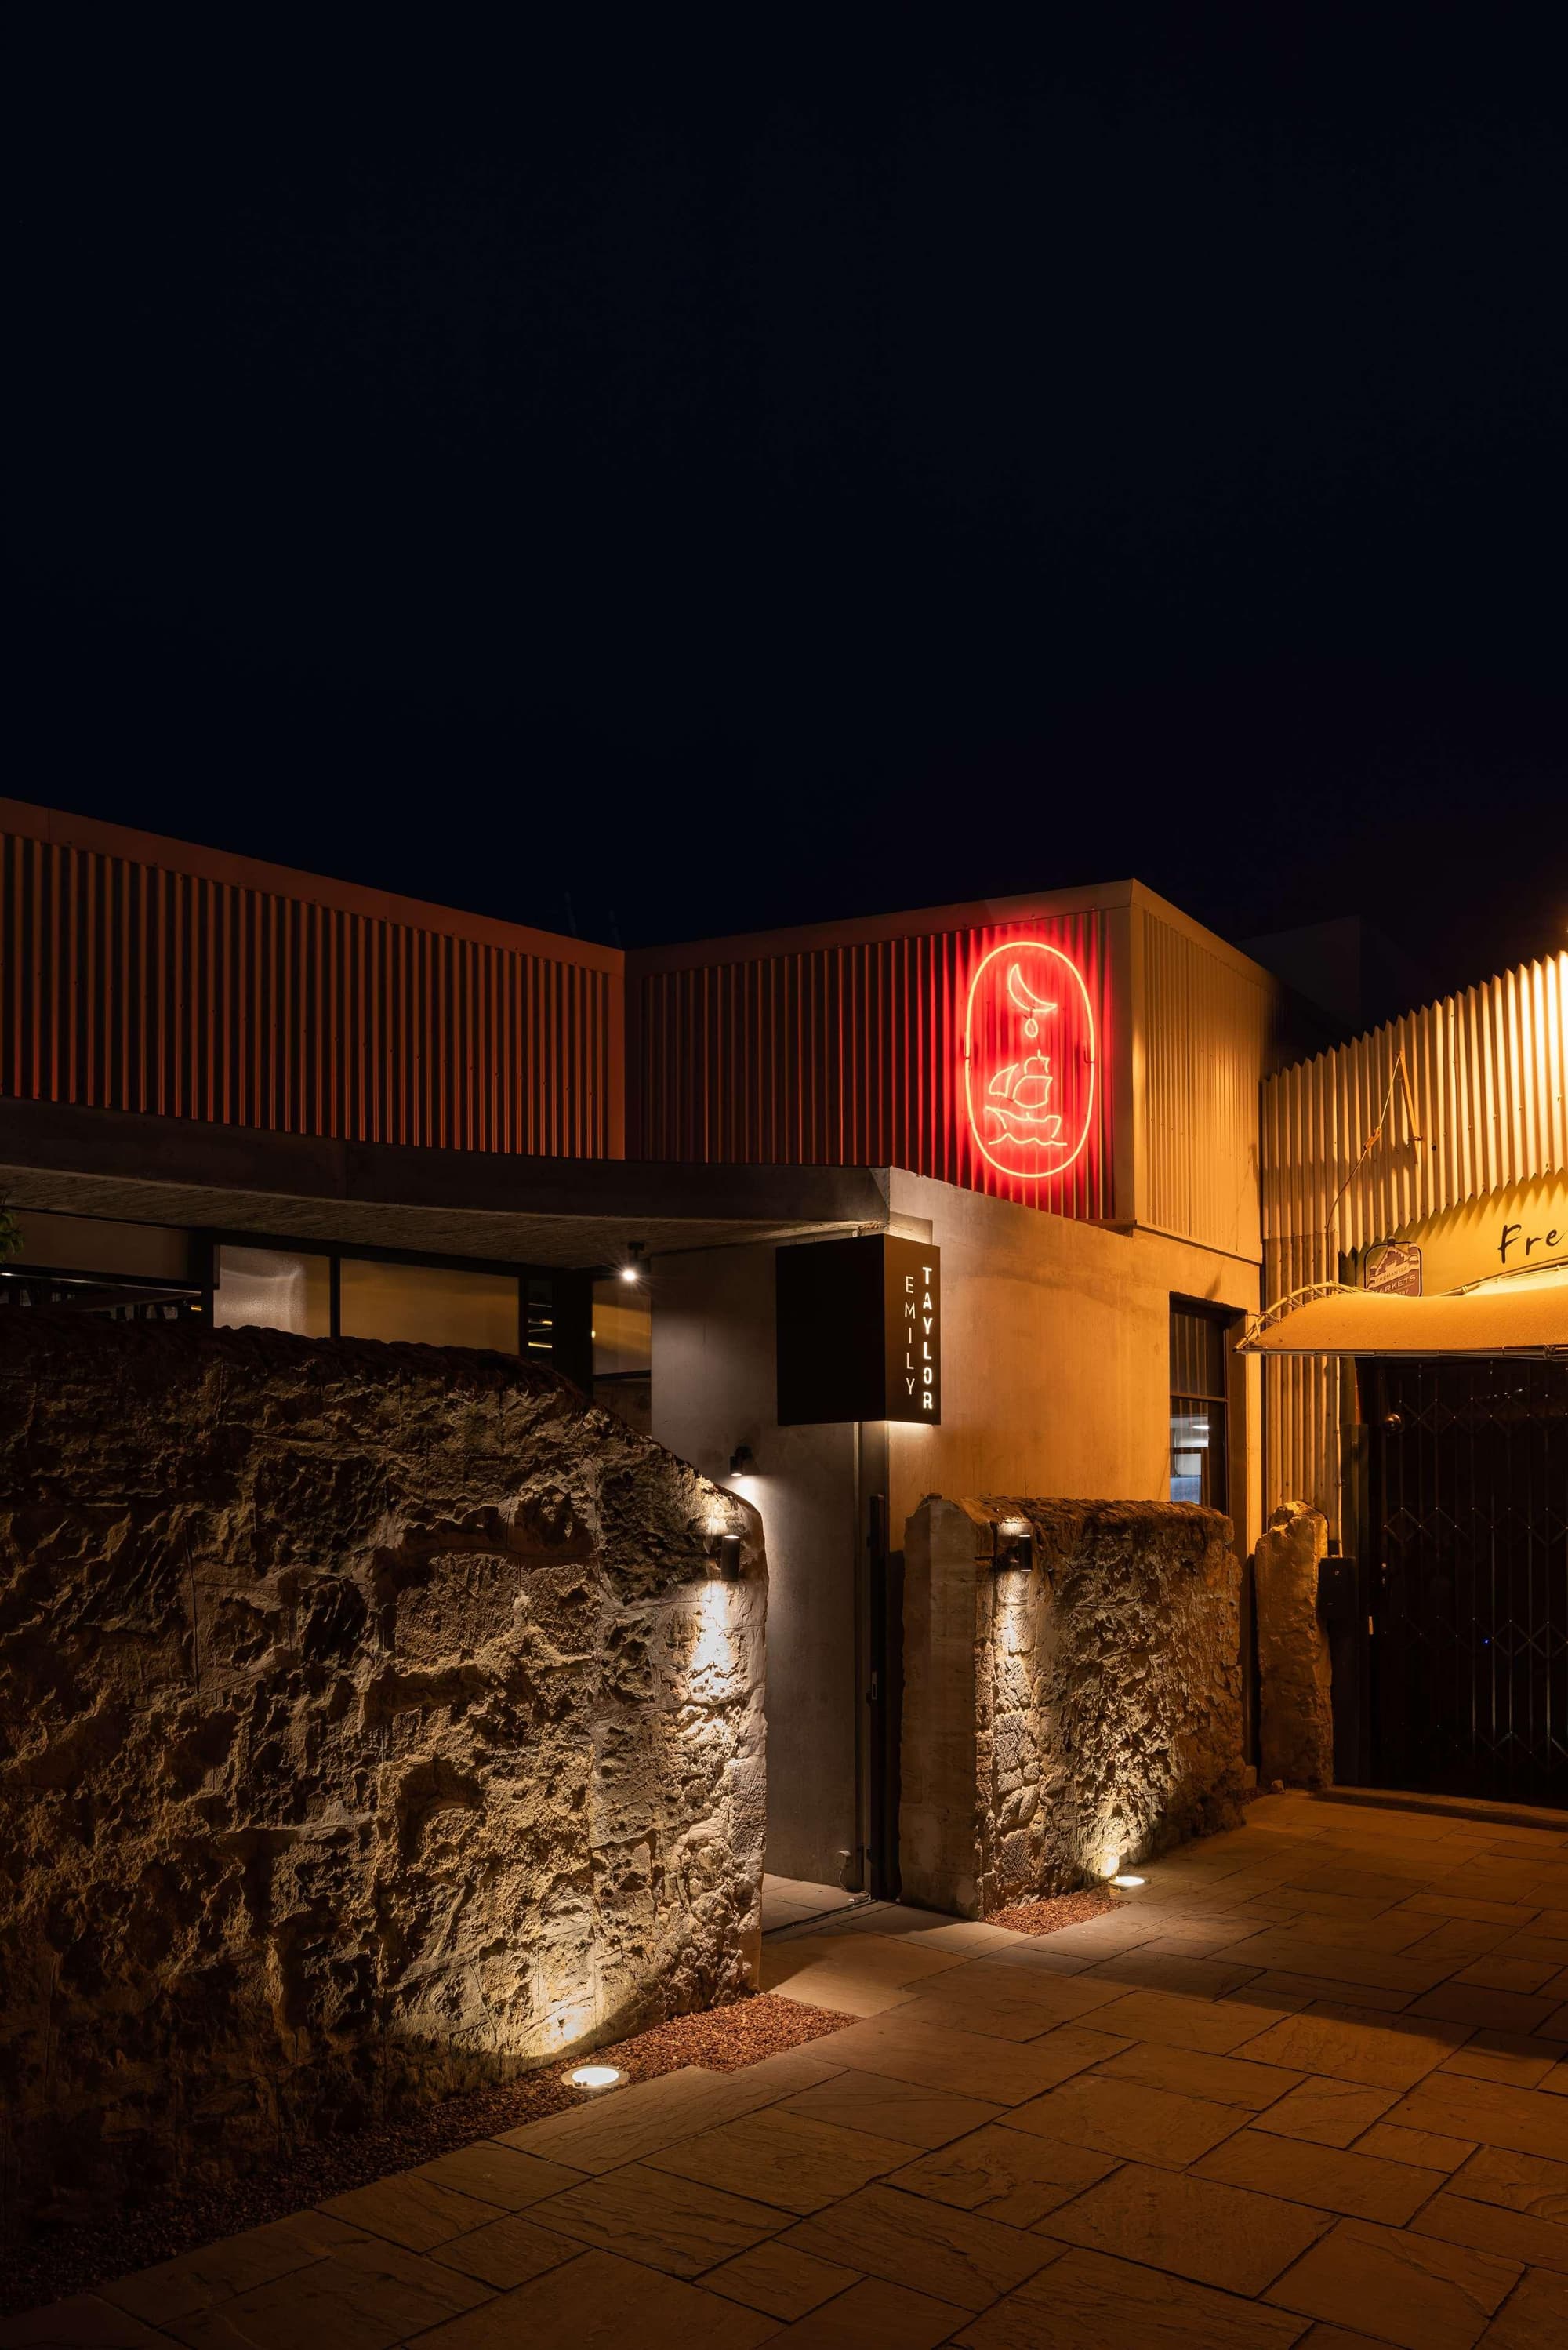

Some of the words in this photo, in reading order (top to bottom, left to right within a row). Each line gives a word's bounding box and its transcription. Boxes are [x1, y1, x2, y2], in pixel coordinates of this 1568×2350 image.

[1497, 1223, 1568, 1264] Fre
[904, 1276, 916, 1395] EMILY
[922, 1266, 933, 1410] TAYLOR
